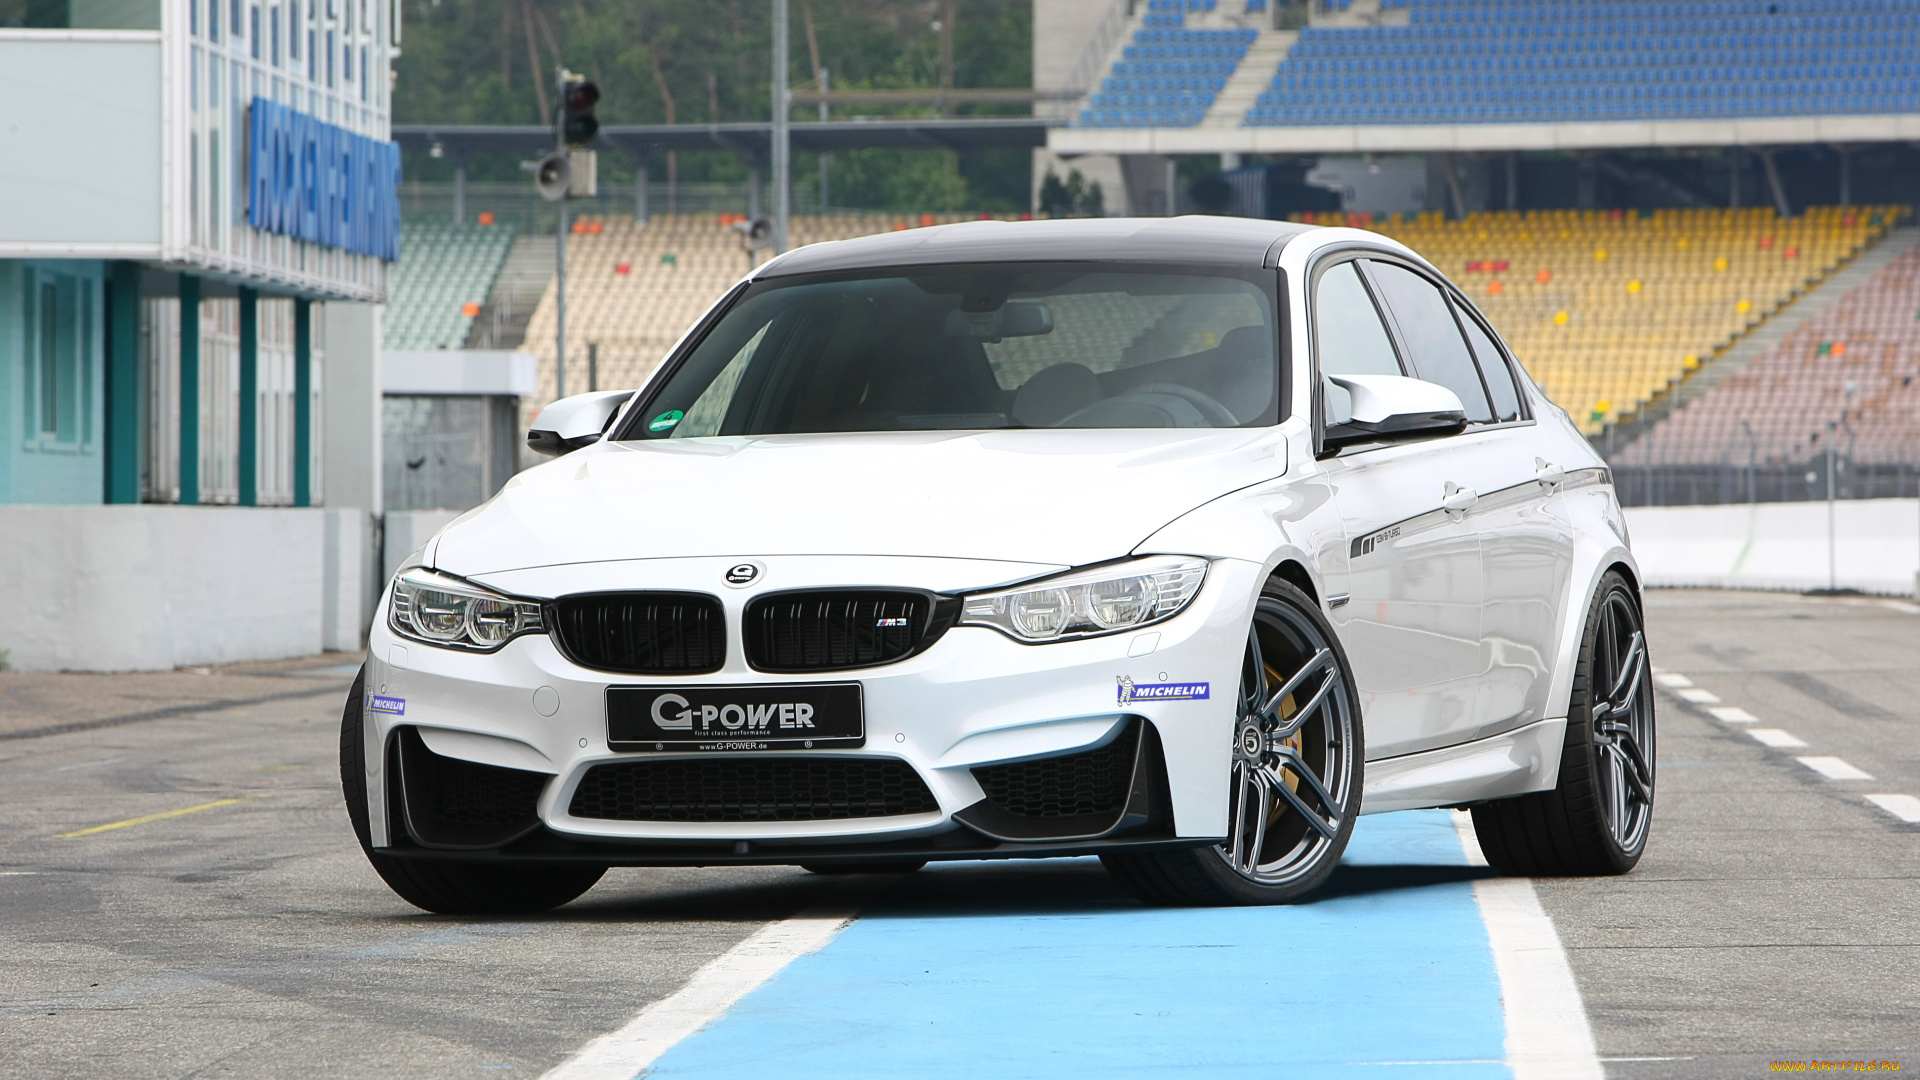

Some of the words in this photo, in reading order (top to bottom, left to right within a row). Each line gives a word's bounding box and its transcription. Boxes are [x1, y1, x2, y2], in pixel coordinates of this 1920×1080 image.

[1135, 685, 1207, 698] MICHELIN
[373, 698, 405, 711] MICHELIN
[650, 692, 816, 731] G-POWER
[729, 729, 771, 737] performance
